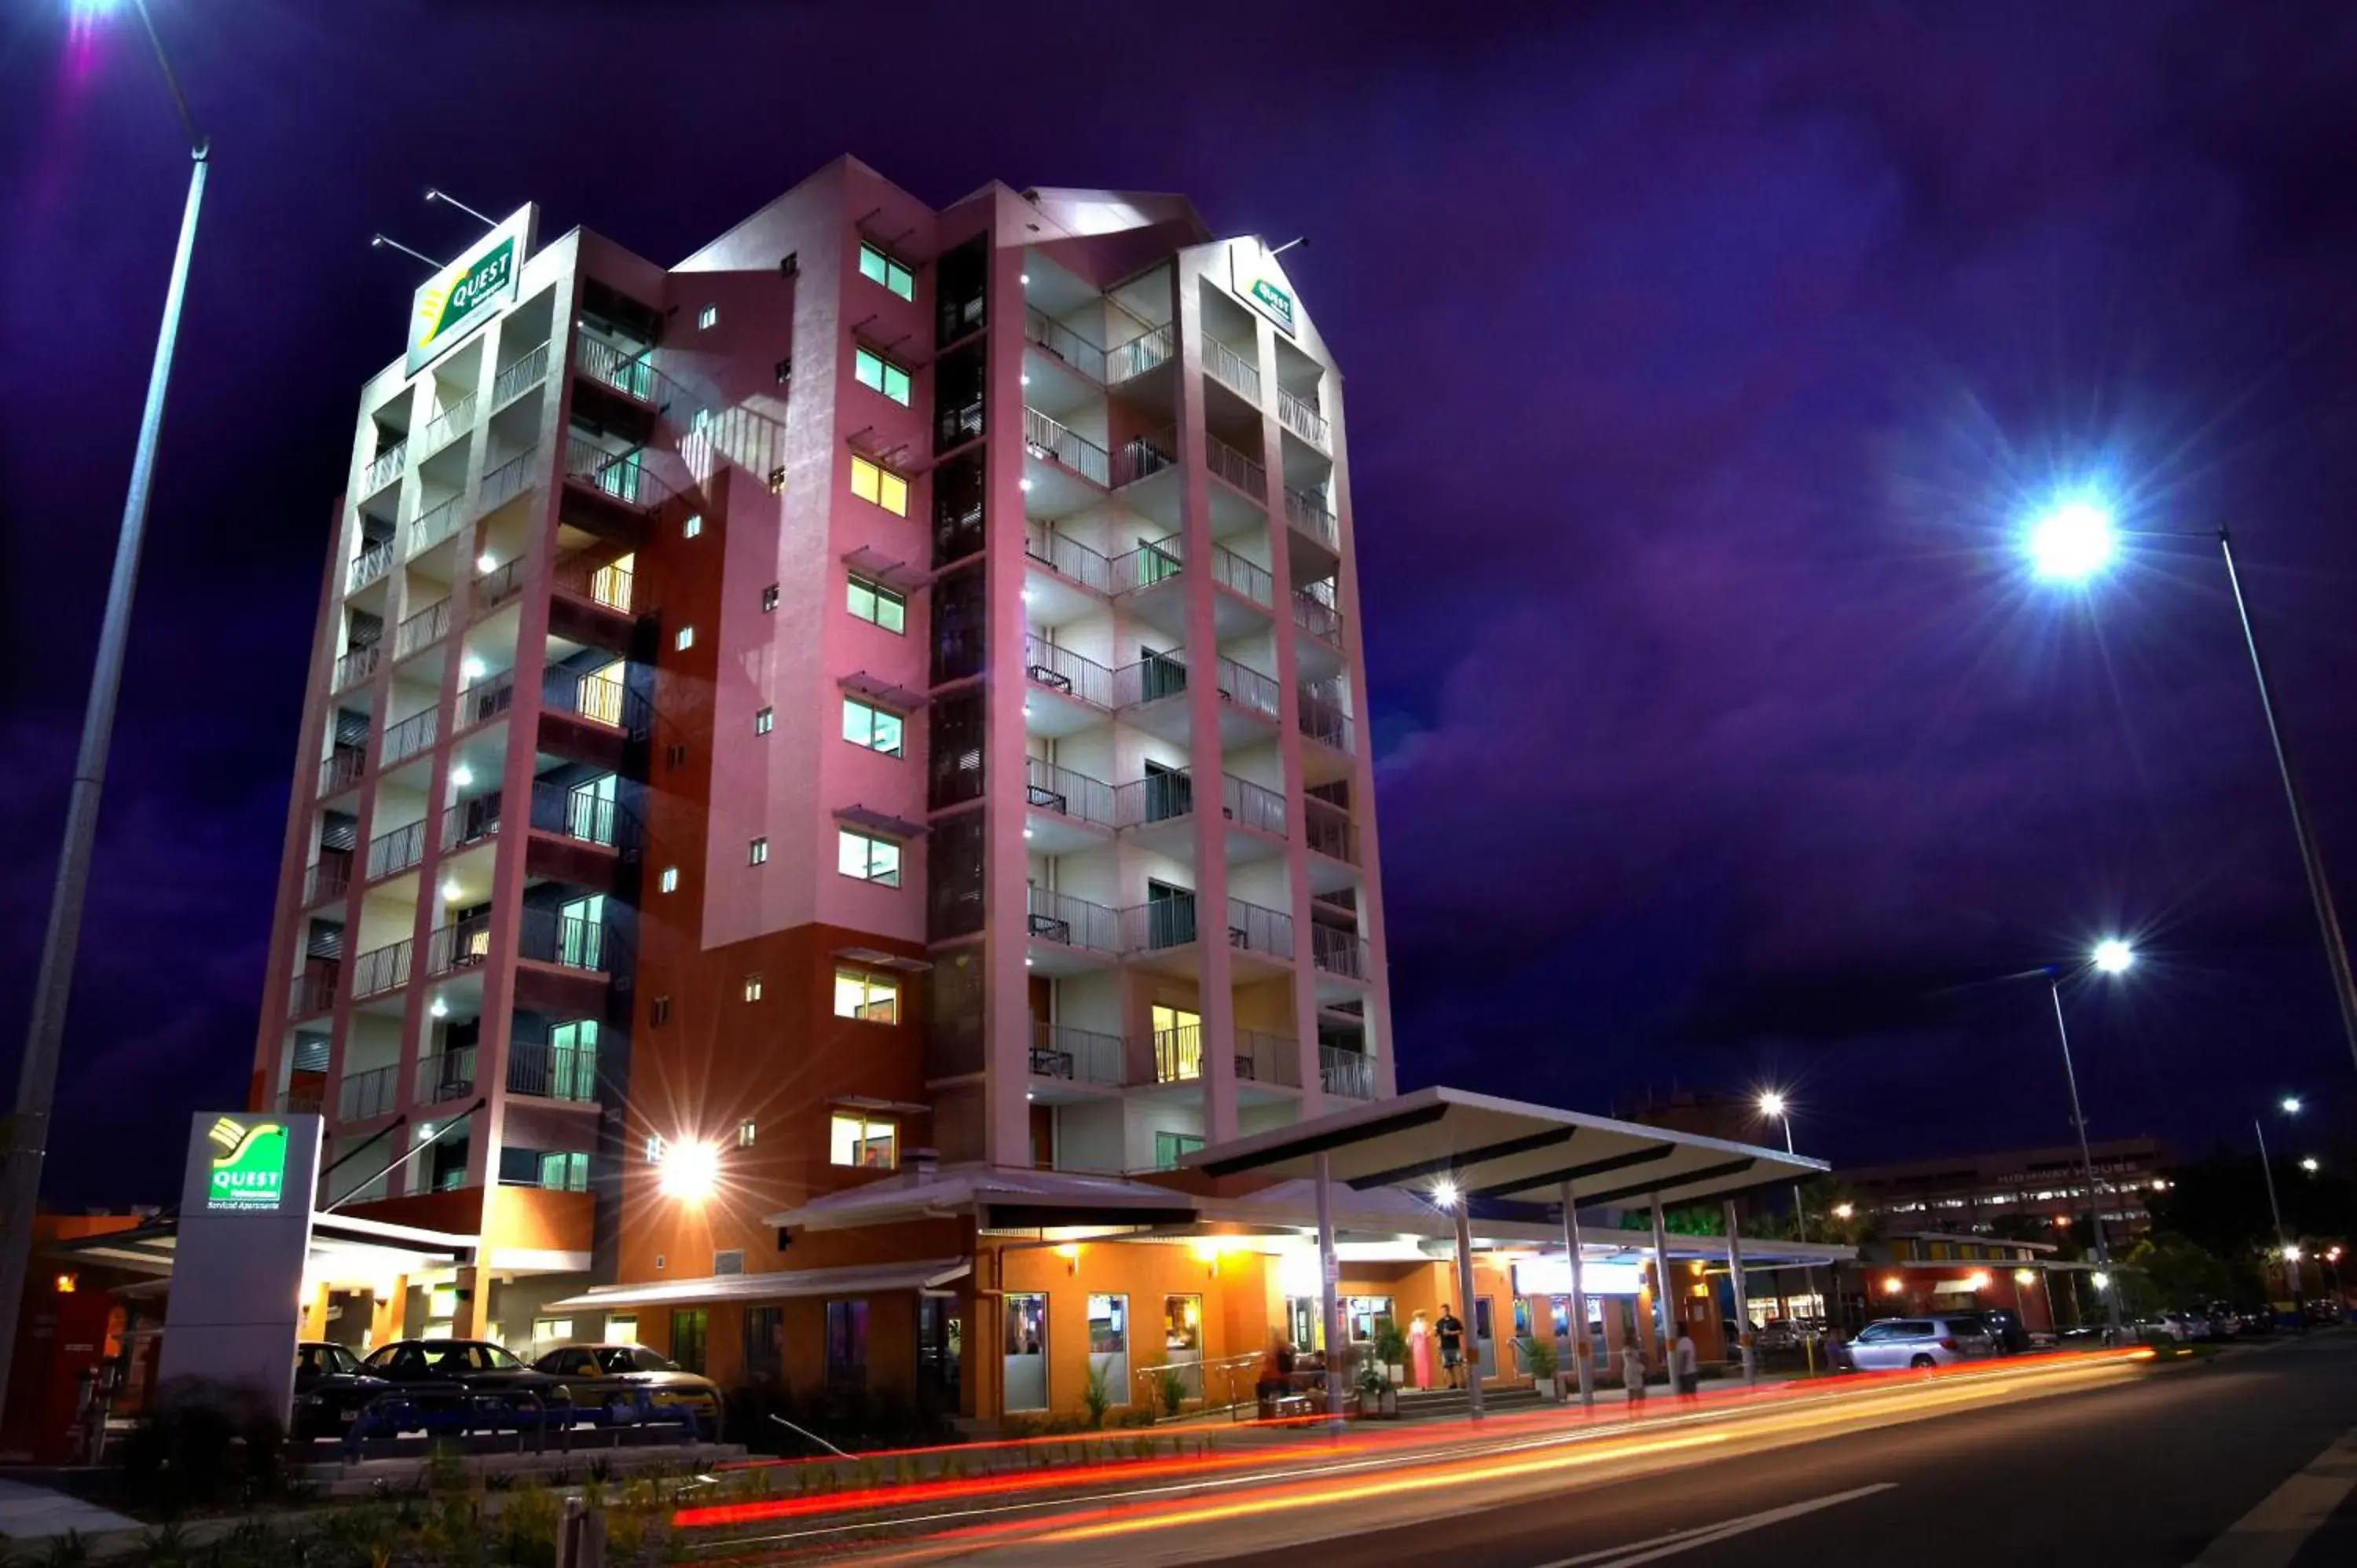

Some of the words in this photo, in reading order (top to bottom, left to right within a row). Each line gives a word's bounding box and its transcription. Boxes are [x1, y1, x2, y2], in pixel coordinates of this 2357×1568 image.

[453, 252, 510, 308] QUEST
[1259, 283, 1289, 313] QUEST
[214, 1171, 278, 1189] QUEST
